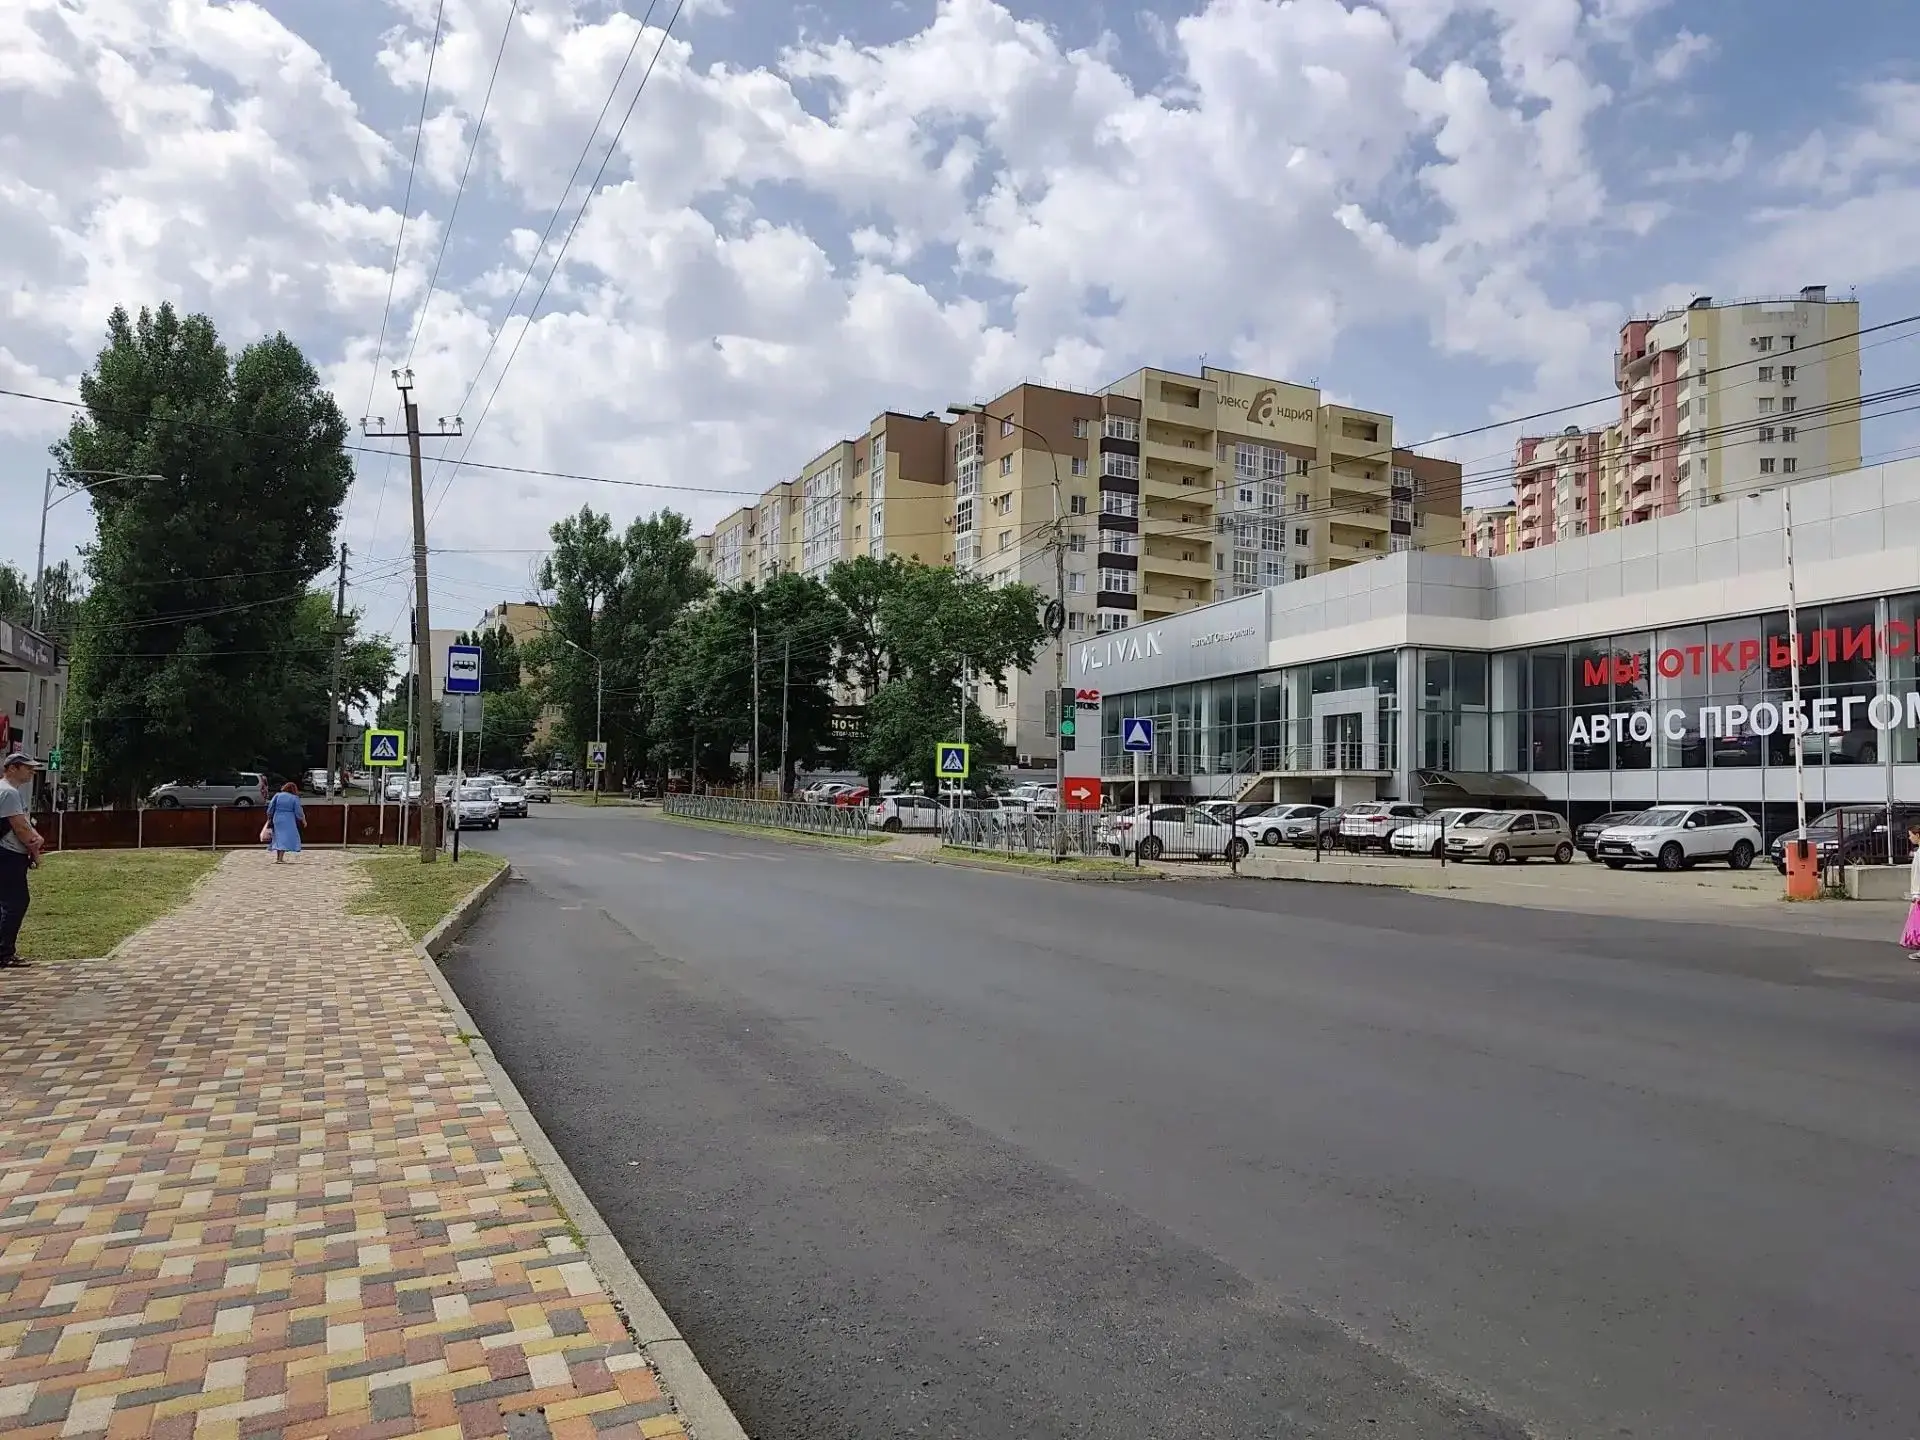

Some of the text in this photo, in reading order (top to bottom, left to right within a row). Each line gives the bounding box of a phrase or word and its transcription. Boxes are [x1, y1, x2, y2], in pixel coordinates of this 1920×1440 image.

[1090, 630, 1162, 669] LIVAN
[1584, 618, 1920, 687] МЫ ОТКРЫЛИС
[1076, 689, 1099, 700] AC
[1568, 710, 1652, 745] АВТО
[1663, 708, 1686, 740] С
